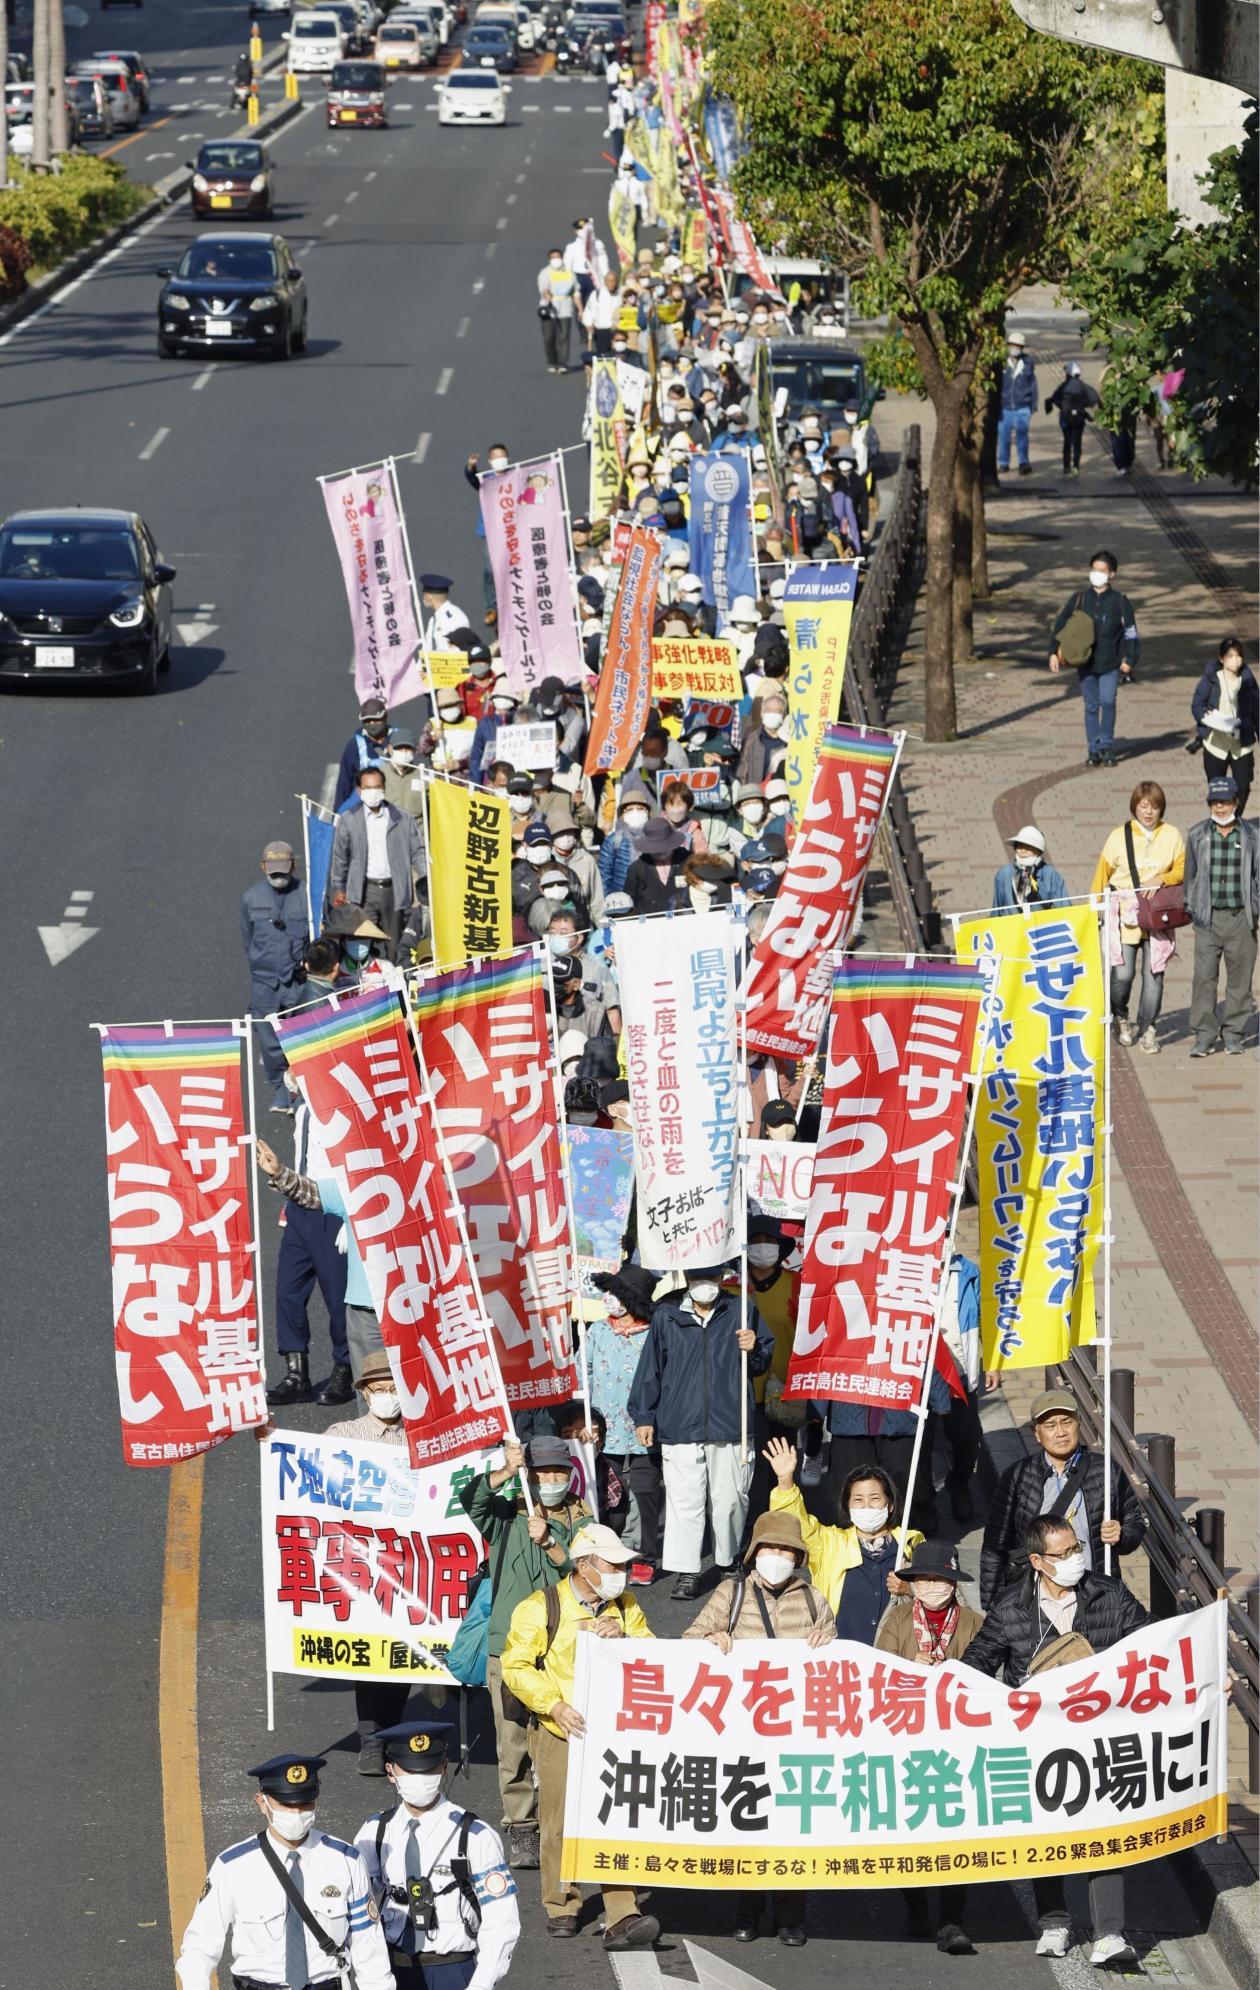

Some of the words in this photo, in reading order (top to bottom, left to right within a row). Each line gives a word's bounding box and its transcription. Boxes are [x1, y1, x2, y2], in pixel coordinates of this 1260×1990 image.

[463, 800, 500, 966] 辺野古新基
[737, 765, 856, 1013] いらない
[785, 769, 885, 1041] ミサイル基地
[488, 1003, 574, 1370] ミサイル基地
[653, 980, 686, 1176] 二度と血の雨を
[690, 948, 736, 1206] 県民よ立ち上がろう
[792, 1012, 899, 1356] いらない
[867, 1005, 963, 1379] ミサイル基地
[105, 1082, 207, 1424] いらない
[179, 1075, 268, 1432] ミサイル基地
[297, 1061, 451, 1420] いらない
[363, 1040, 505, 1416] ミサイル基地
[646, 1186, 714, 1230] 文子おばー
[663, 1217, 698, 1243] と共に
[416, 1416, 502, 1460] 宮古島住民連絡会
[790, 1371, 913, 1400] 宮古島住民連絡会
[276, 1515, 489, 1625] 軍事利用
[616, 1636, 1197, 1739] 島々を戦場にするな！
[598, 1719, 1210, 1834] 沖縄を平和発信の場に！
